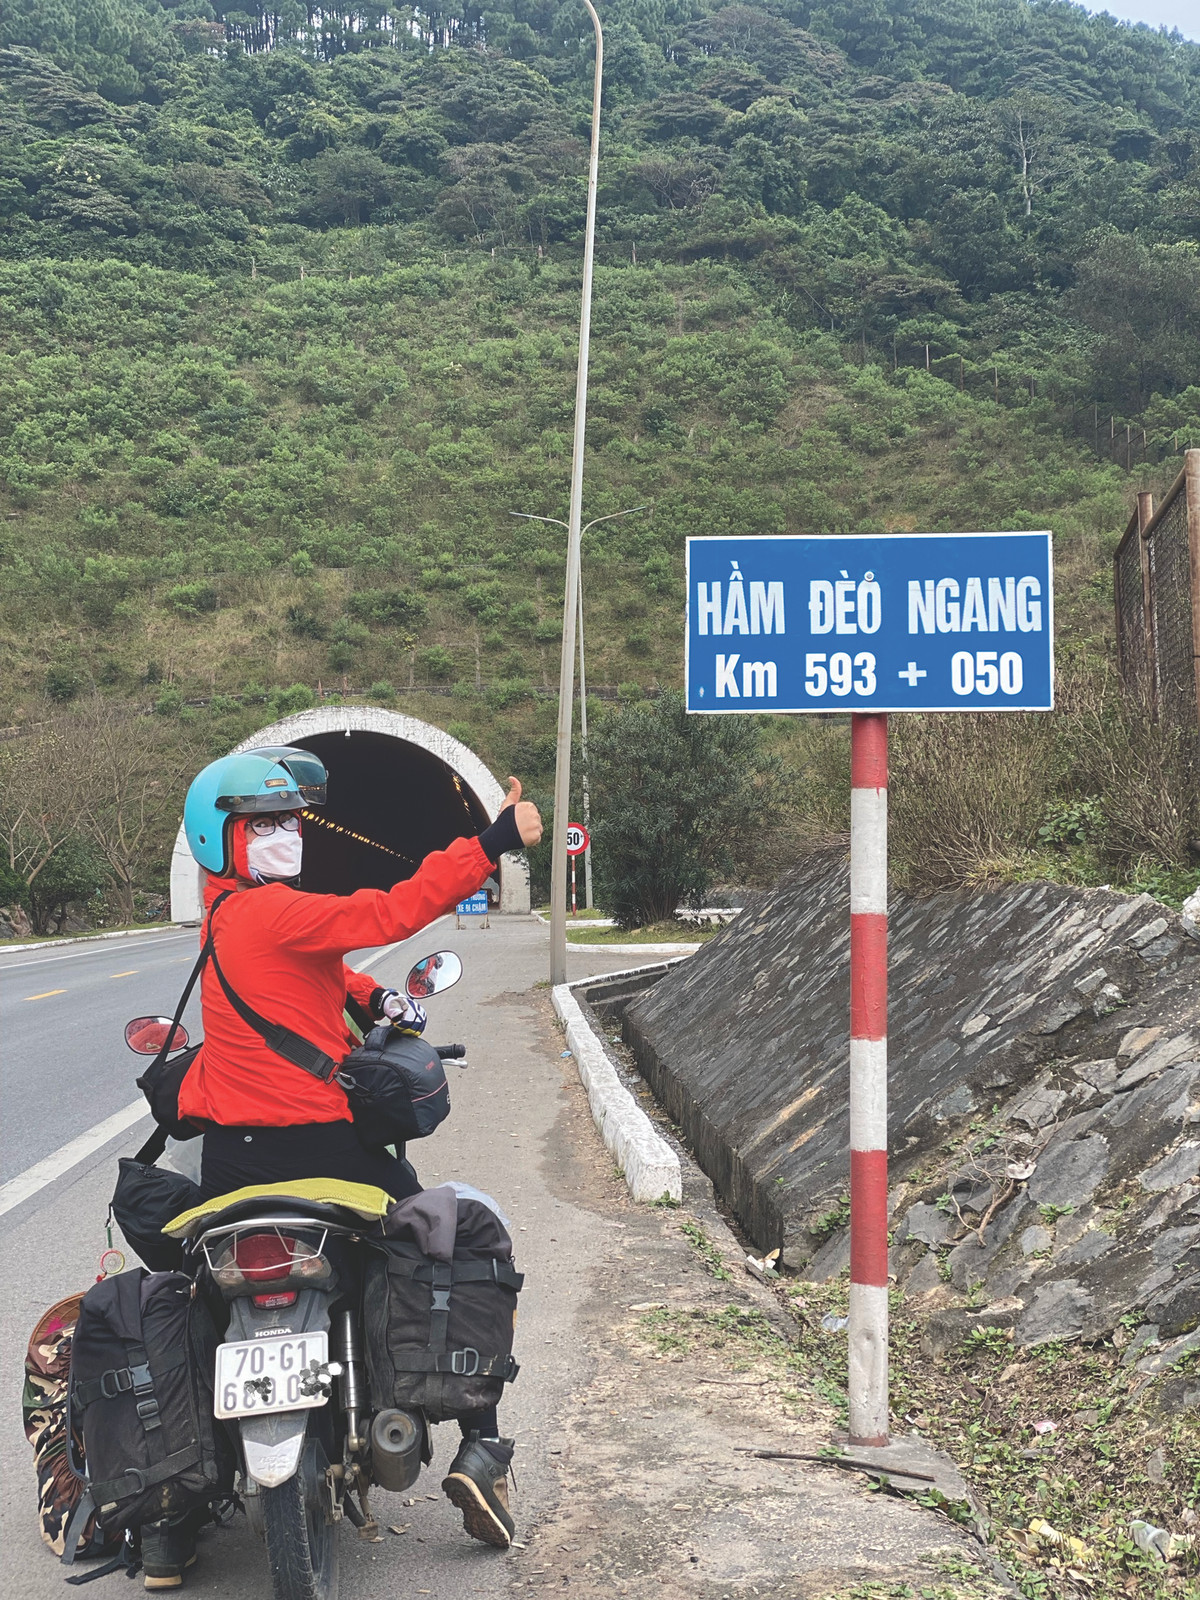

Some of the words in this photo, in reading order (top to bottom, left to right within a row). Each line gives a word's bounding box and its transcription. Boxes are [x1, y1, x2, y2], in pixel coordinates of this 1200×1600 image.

[697, 560, 786, 636] HẦM
[907, 575, 1042, 634] NGANG
[715, 653, 778, 698] Km
[804, 651, 877, 697] 593
[898, 661, 927, 687] +
[951, 651, 1024, 696] 050
[567, 832, 580, 846] 50
[254, 1328, 292, 1338] HONDA
[235, 1340, 307, 1378] 70-G1
